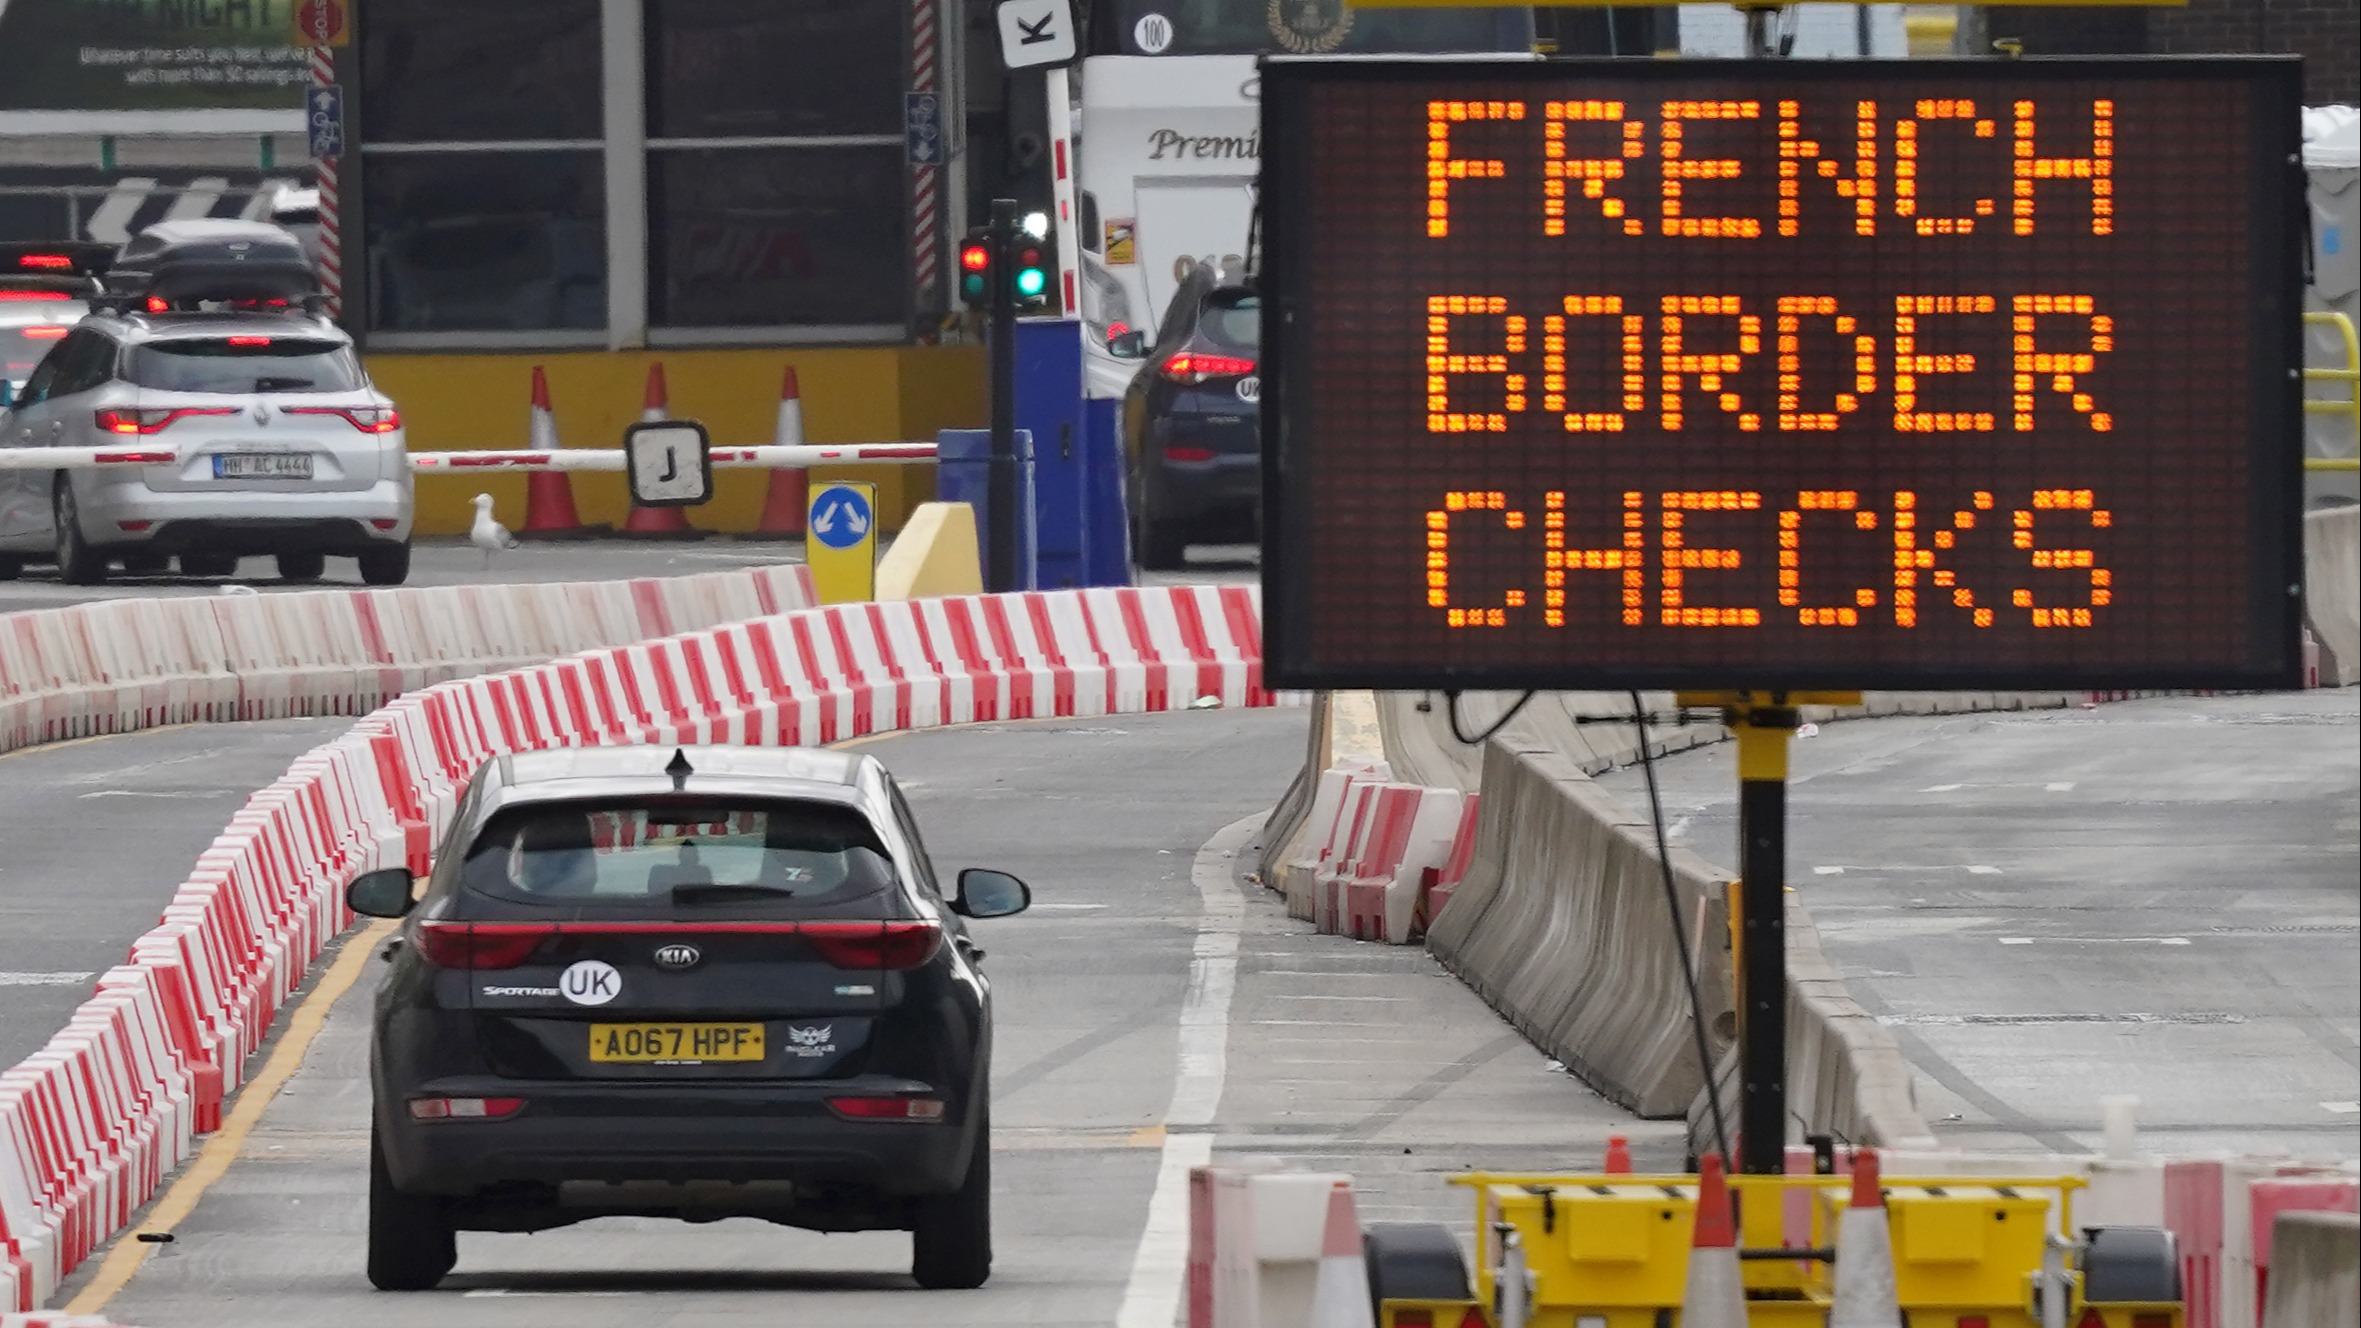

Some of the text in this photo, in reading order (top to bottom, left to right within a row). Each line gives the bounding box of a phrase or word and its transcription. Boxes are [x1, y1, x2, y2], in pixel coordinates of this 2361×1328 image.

[314, 0, 328, 40] STOP
[1017, 10, 1055, 46] K
[1143, 20, 1167, 48] 100
[1427, 99, 2115, 236] FRENCH
[1427, 295, 2114, 432] BORDER
[659, 446, 676, 483] J
[1427, 490, 2113, 626] CHECKS
[662, 949, 692, 964] KIA
[568, 969, 615, 996] UK
[693, 1028, 751, 1056] HPF
